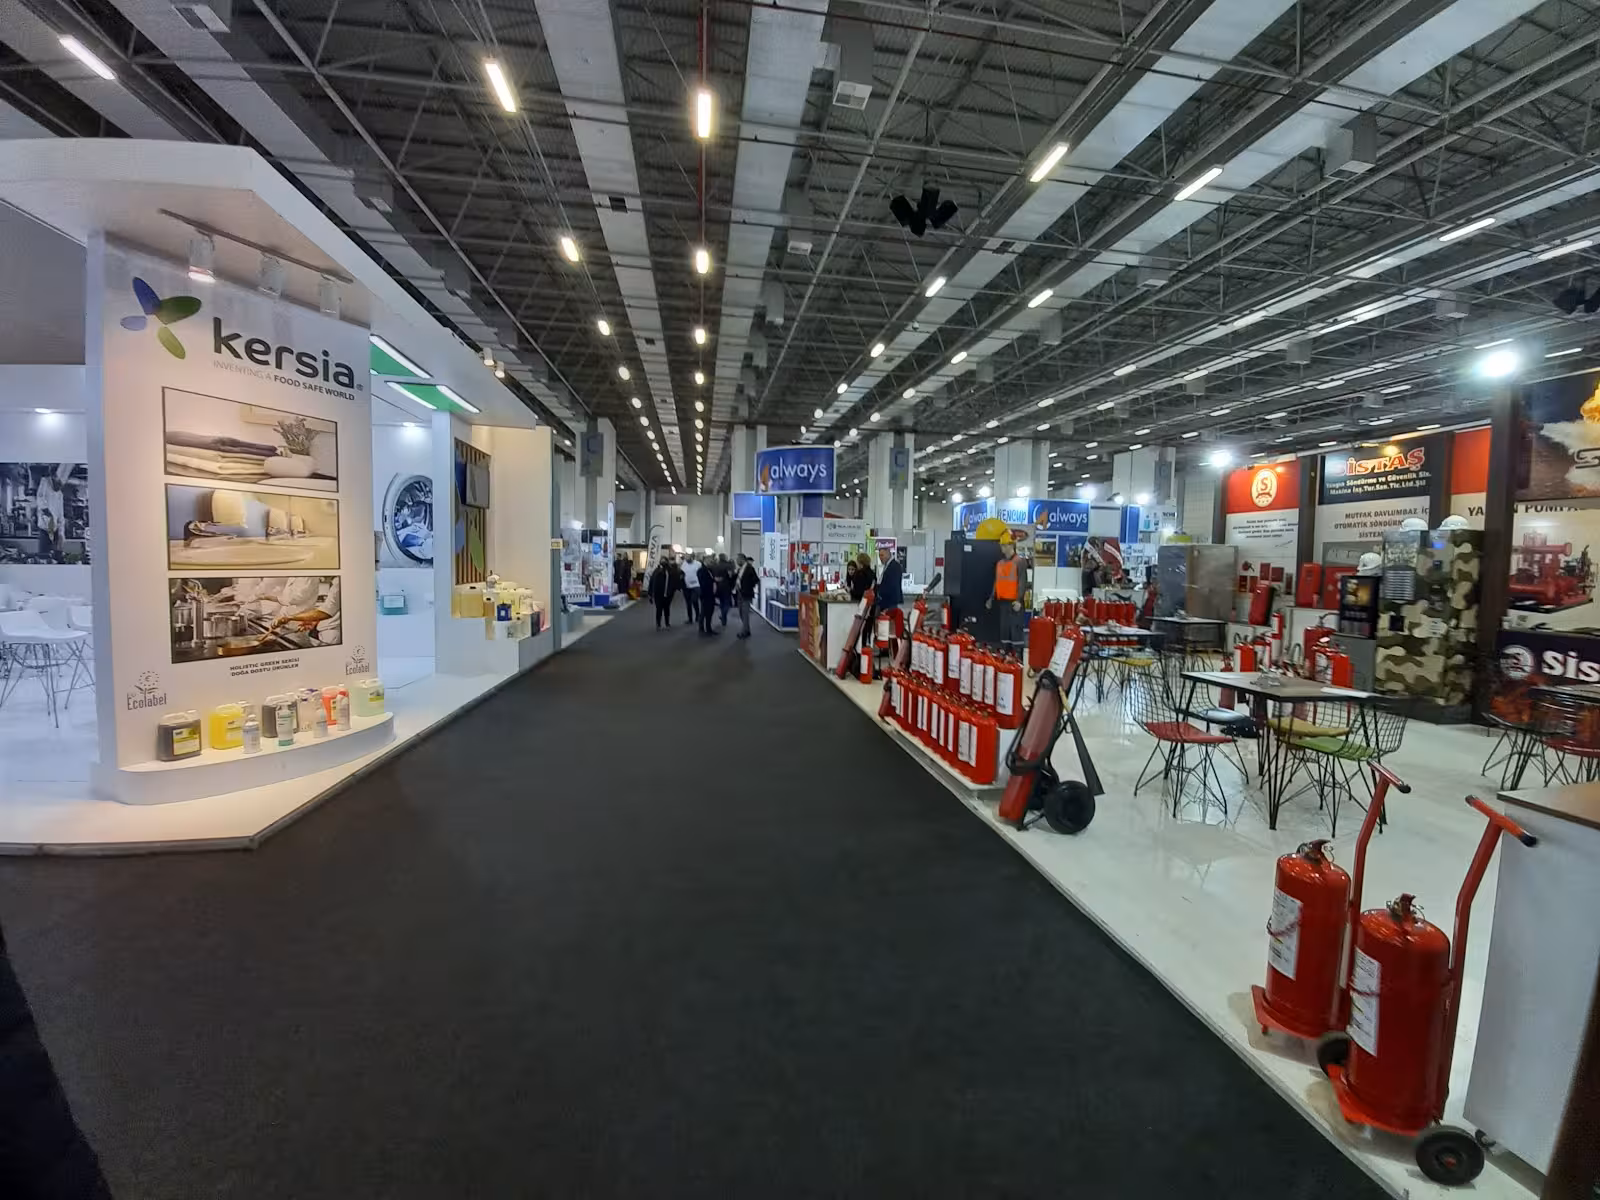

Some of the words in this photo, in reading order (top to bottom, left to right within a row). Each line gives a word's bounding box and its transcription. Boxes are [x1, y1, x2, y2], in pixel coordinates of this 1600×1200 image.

[213, 316, 354, 389] kersia
[213, 360, 263, 378] INVENTING
[274, 374, 300, 388] FOOD
[302, 382, 323, 394] SAFE
[325, 387, 355, 400] WORLD
[770, 456, 827, 483] always
[1328, 447, 1425, 476] İSTAŞ
[1049, 506, 1087, 528] always
[1334, 520, 1368, 529] OTOMATİK
[1369, 517, 1403, 528] SÖNDÜRM
[1345, 511, 1373, 519] MUTFAK
[1374, 507, 1418, 517] DAVLUMBAZ
[1358, 531, 1384, 539] SİSTEM
[345, 662, 369, 676] Ecolabel
[127, 692, 167, 711] Ecolabel
